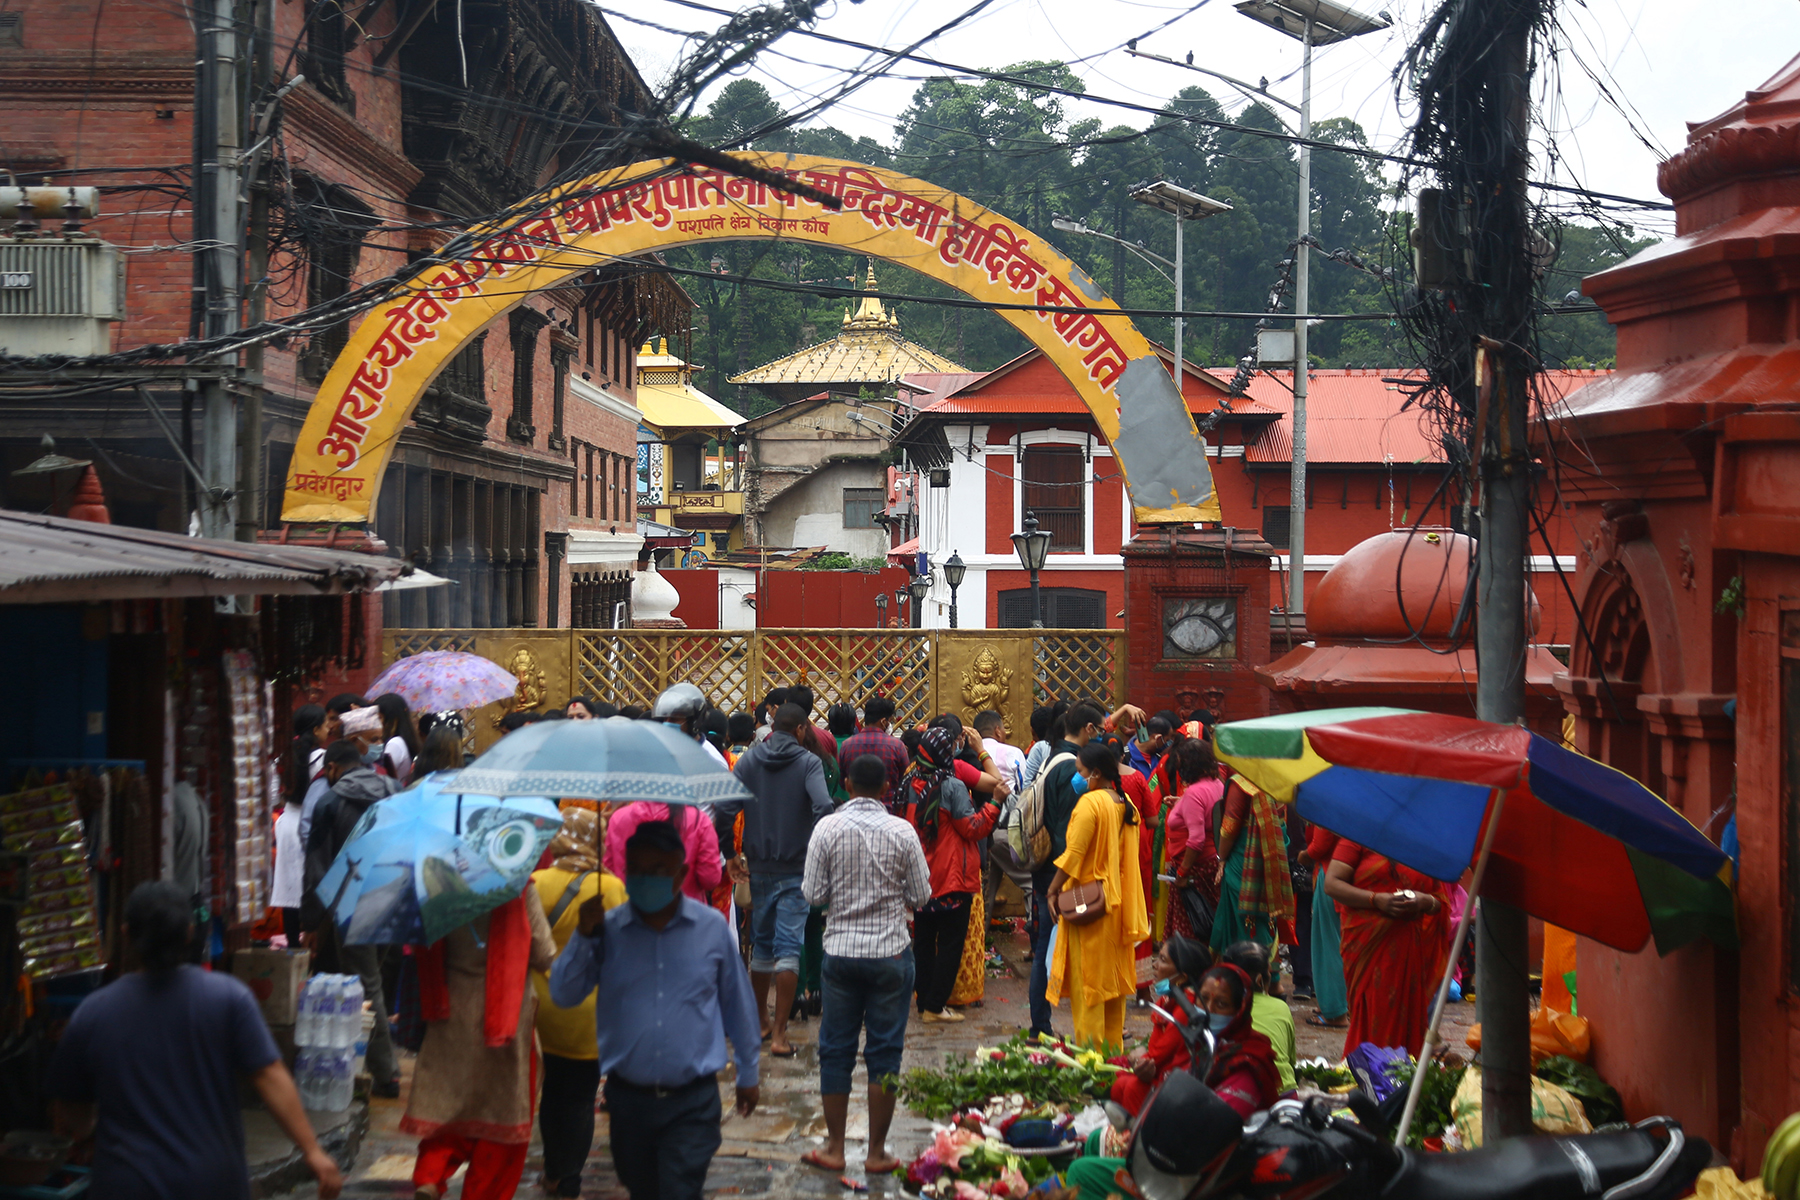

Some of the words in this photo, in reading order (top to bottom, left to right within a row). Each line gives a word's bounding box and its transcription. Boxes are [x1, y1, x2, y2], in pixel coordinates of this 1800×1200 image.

[676, 213, 726, 235] पशुपति
[730, 212, 751, 231] क्षेत्र
[757, 213, 798, 233] विकास
[802, 216, 830, 236] कोष
[3, 274, 30, 287] 100
[317, 286, 452, 471] आराध्यदेव
[939, 215, 1048, 293] हार्दिक
[1034, 274, 1128, 393] स्वागत
[294, 469, 365, 502] प्रवेशद्वार
